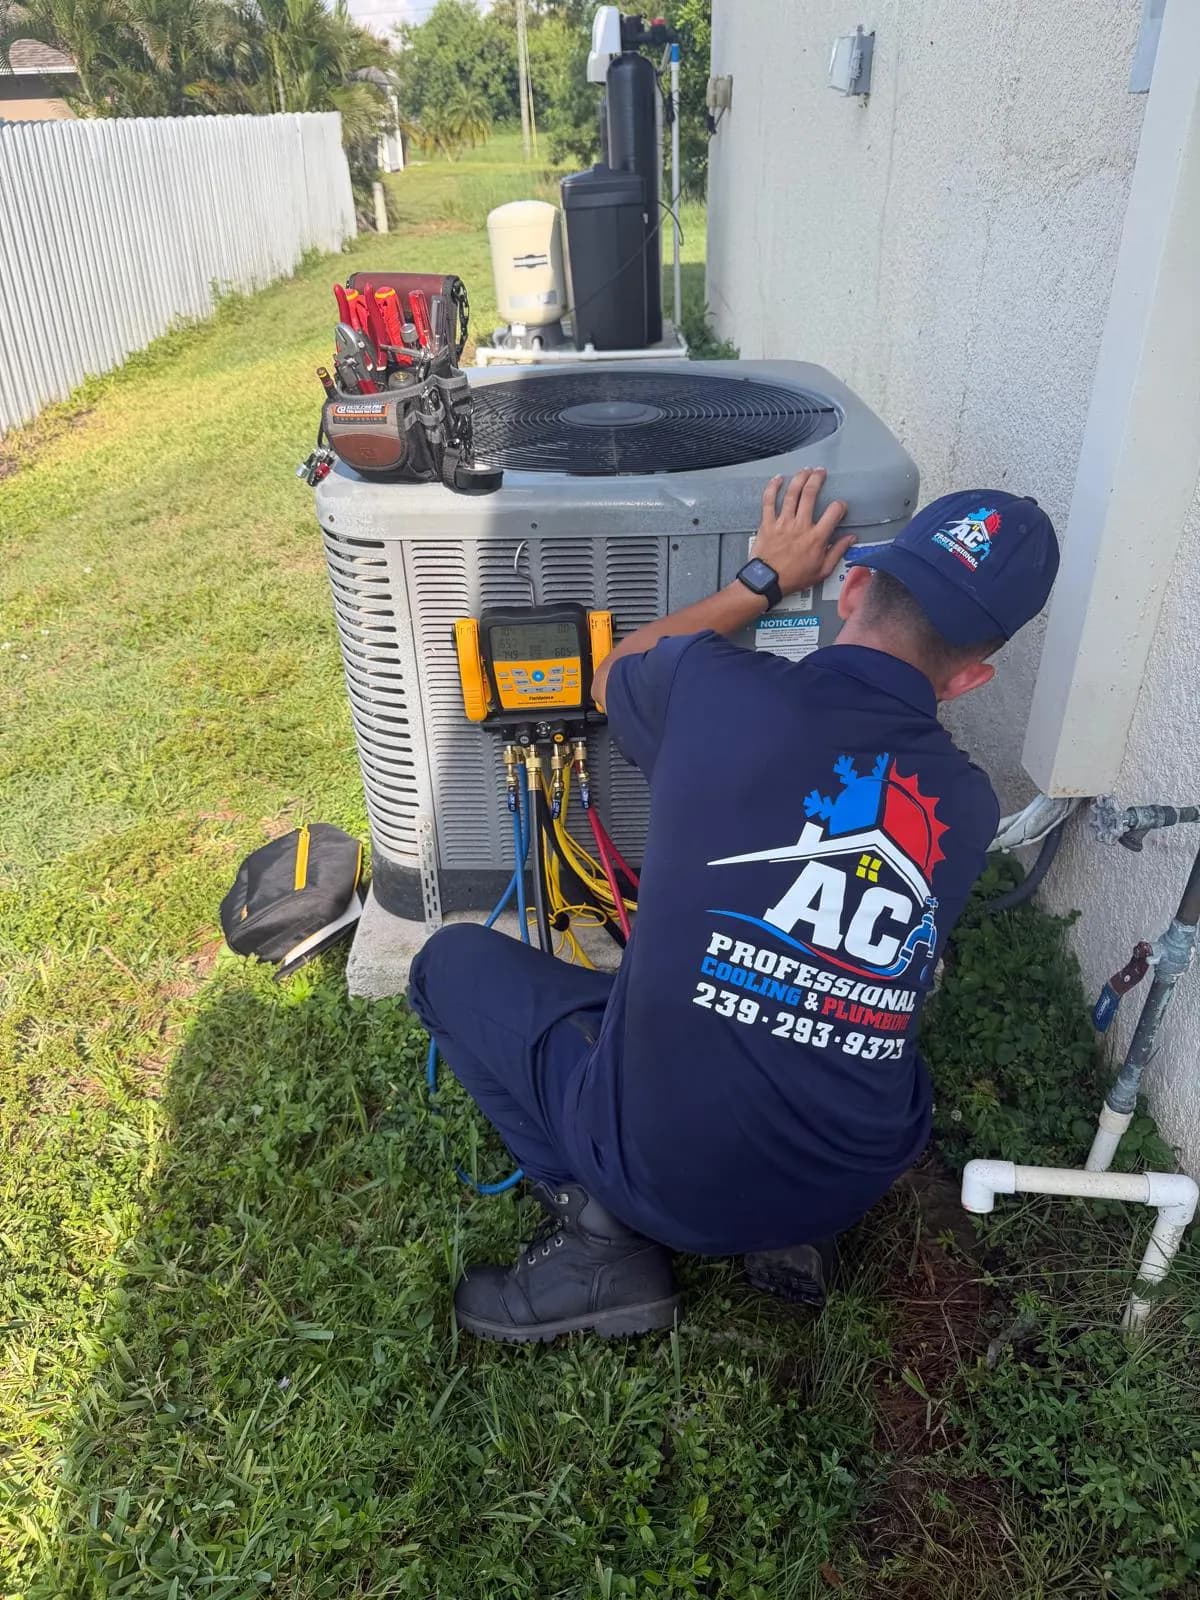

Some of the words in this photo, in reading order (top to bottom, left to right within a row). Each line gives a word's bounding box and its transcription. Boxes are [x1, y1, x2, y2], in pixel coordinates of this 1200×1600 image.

[949, 524, 984, 549] AC
[760, 618, 818, 628] NOTICE/AVIS
[763, 860, 913, 966] AC
[700, 956, 801, 1006] COOLING
[803, 991, 819, 1012] &
[706, 931, 917, 1013] PROFESSIONAL
